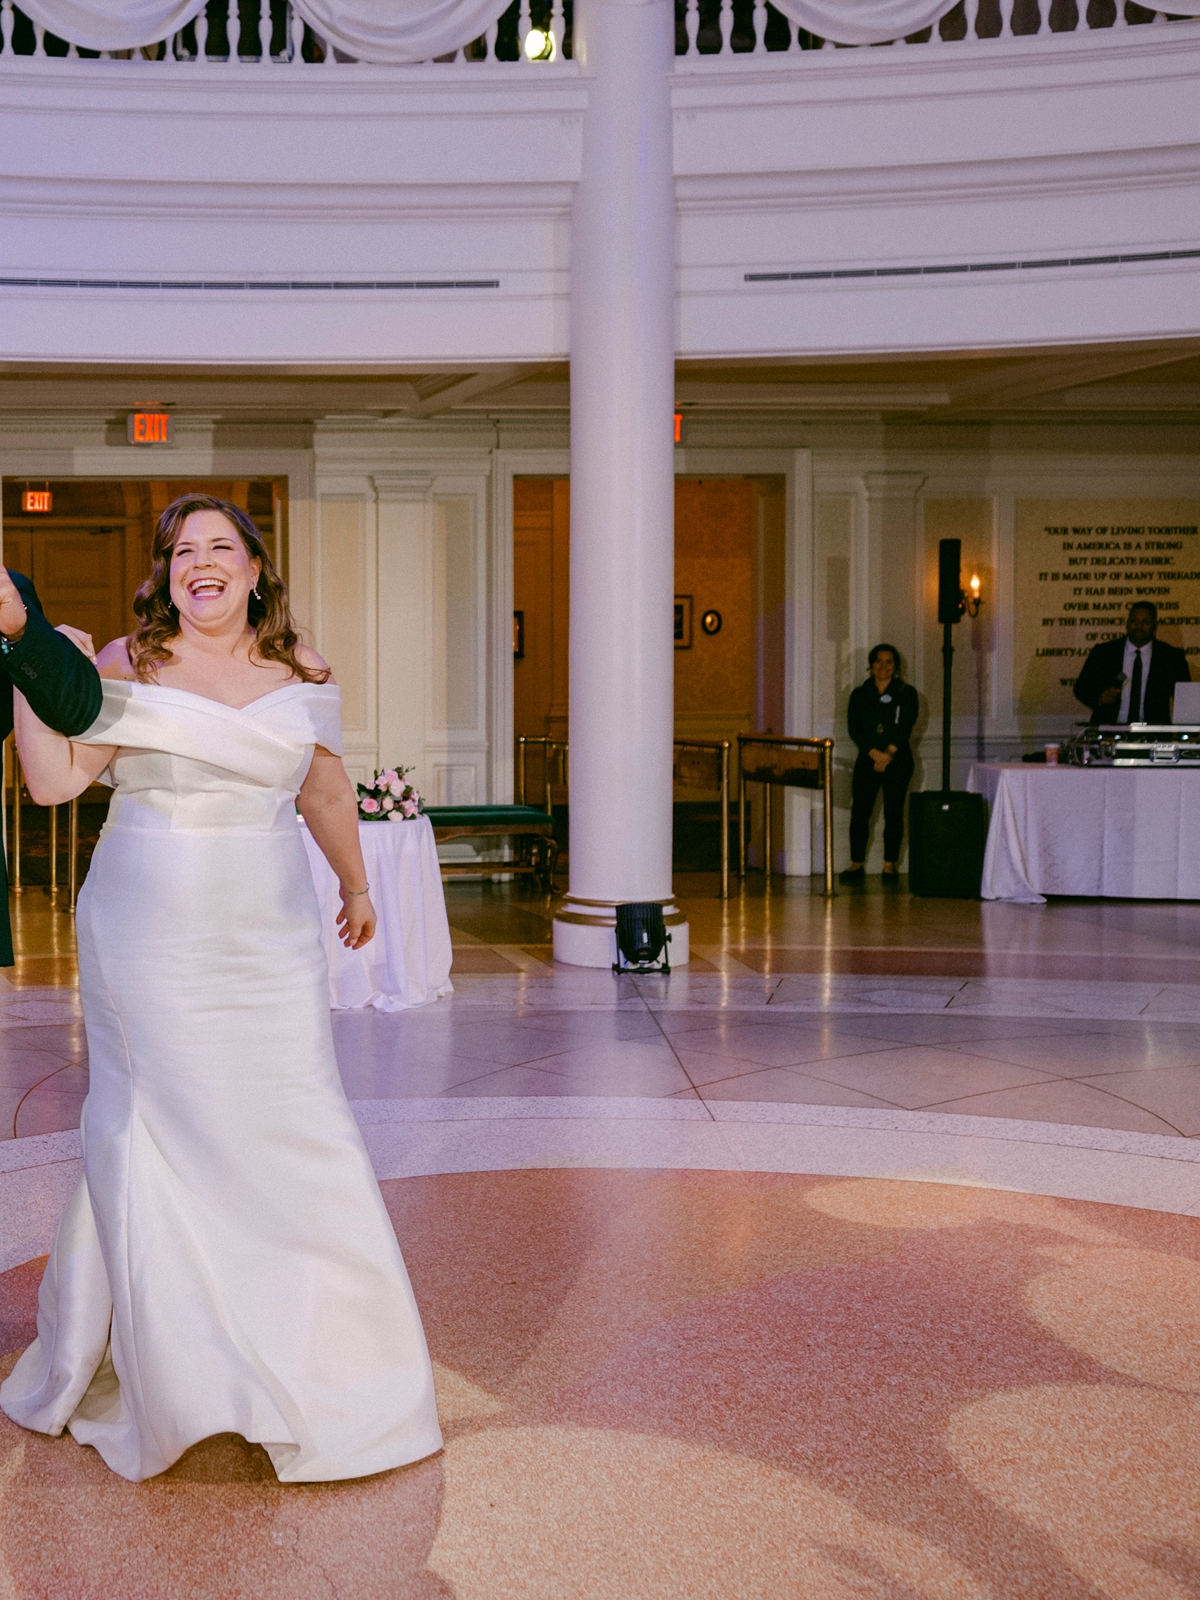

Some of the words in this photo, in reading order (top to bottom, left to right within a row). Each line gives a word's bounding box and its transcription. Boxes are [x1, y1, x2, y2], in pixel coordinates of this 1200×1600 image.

[134, 413, 170, 443] EXIT
[26, 492, 50, 511] EXIT
[1072, 526, 1093, 536] WAY
[1095, 526, 1108, 536] OF
[1111, 526, 1145, 536] LIVING
[1147, 526, 1199, 536] TOGETHER
[1062, 541, 1074, 551] IN
[1076, 541, 1120, 551] AMERICA
[1123, 541, 1132, 551] IS
[1134, 541, 1142, 551] A
[1144, 541, 1183, 551] STRONG
[1068, 556, 1088, 566] BUT
[1090, 556, 1137, 566] DELICATE
[1039, 572, 1049, 581] IT
[1051, 572, 1060, 581] IS
[1062, 572, 1091, 581] MADE
[1094, 572, 1107, 581] UP
[1109, 572, 1122, 581] OF
[1124, 571, 1154, 581] MANY
[1073, 587, 1083, 596] IT
[1085, 587, 1105, 596] HAS
[1108, 587, 1133, 596] BEEN
[1135, 587, 1170, 596] WOVEN
[1063, 602, 1089, 611] OVER
[1092, 602, 1122, 611] MANY
[1042, 617, 1055, 627] BY
[1057, 617, 1077, 627] THE
[1079, 617, 1125, 627] PATIENCE
[1156, 617, 1200, 626] ACRIFICE
[1085, 632, 1098, 641] OF
